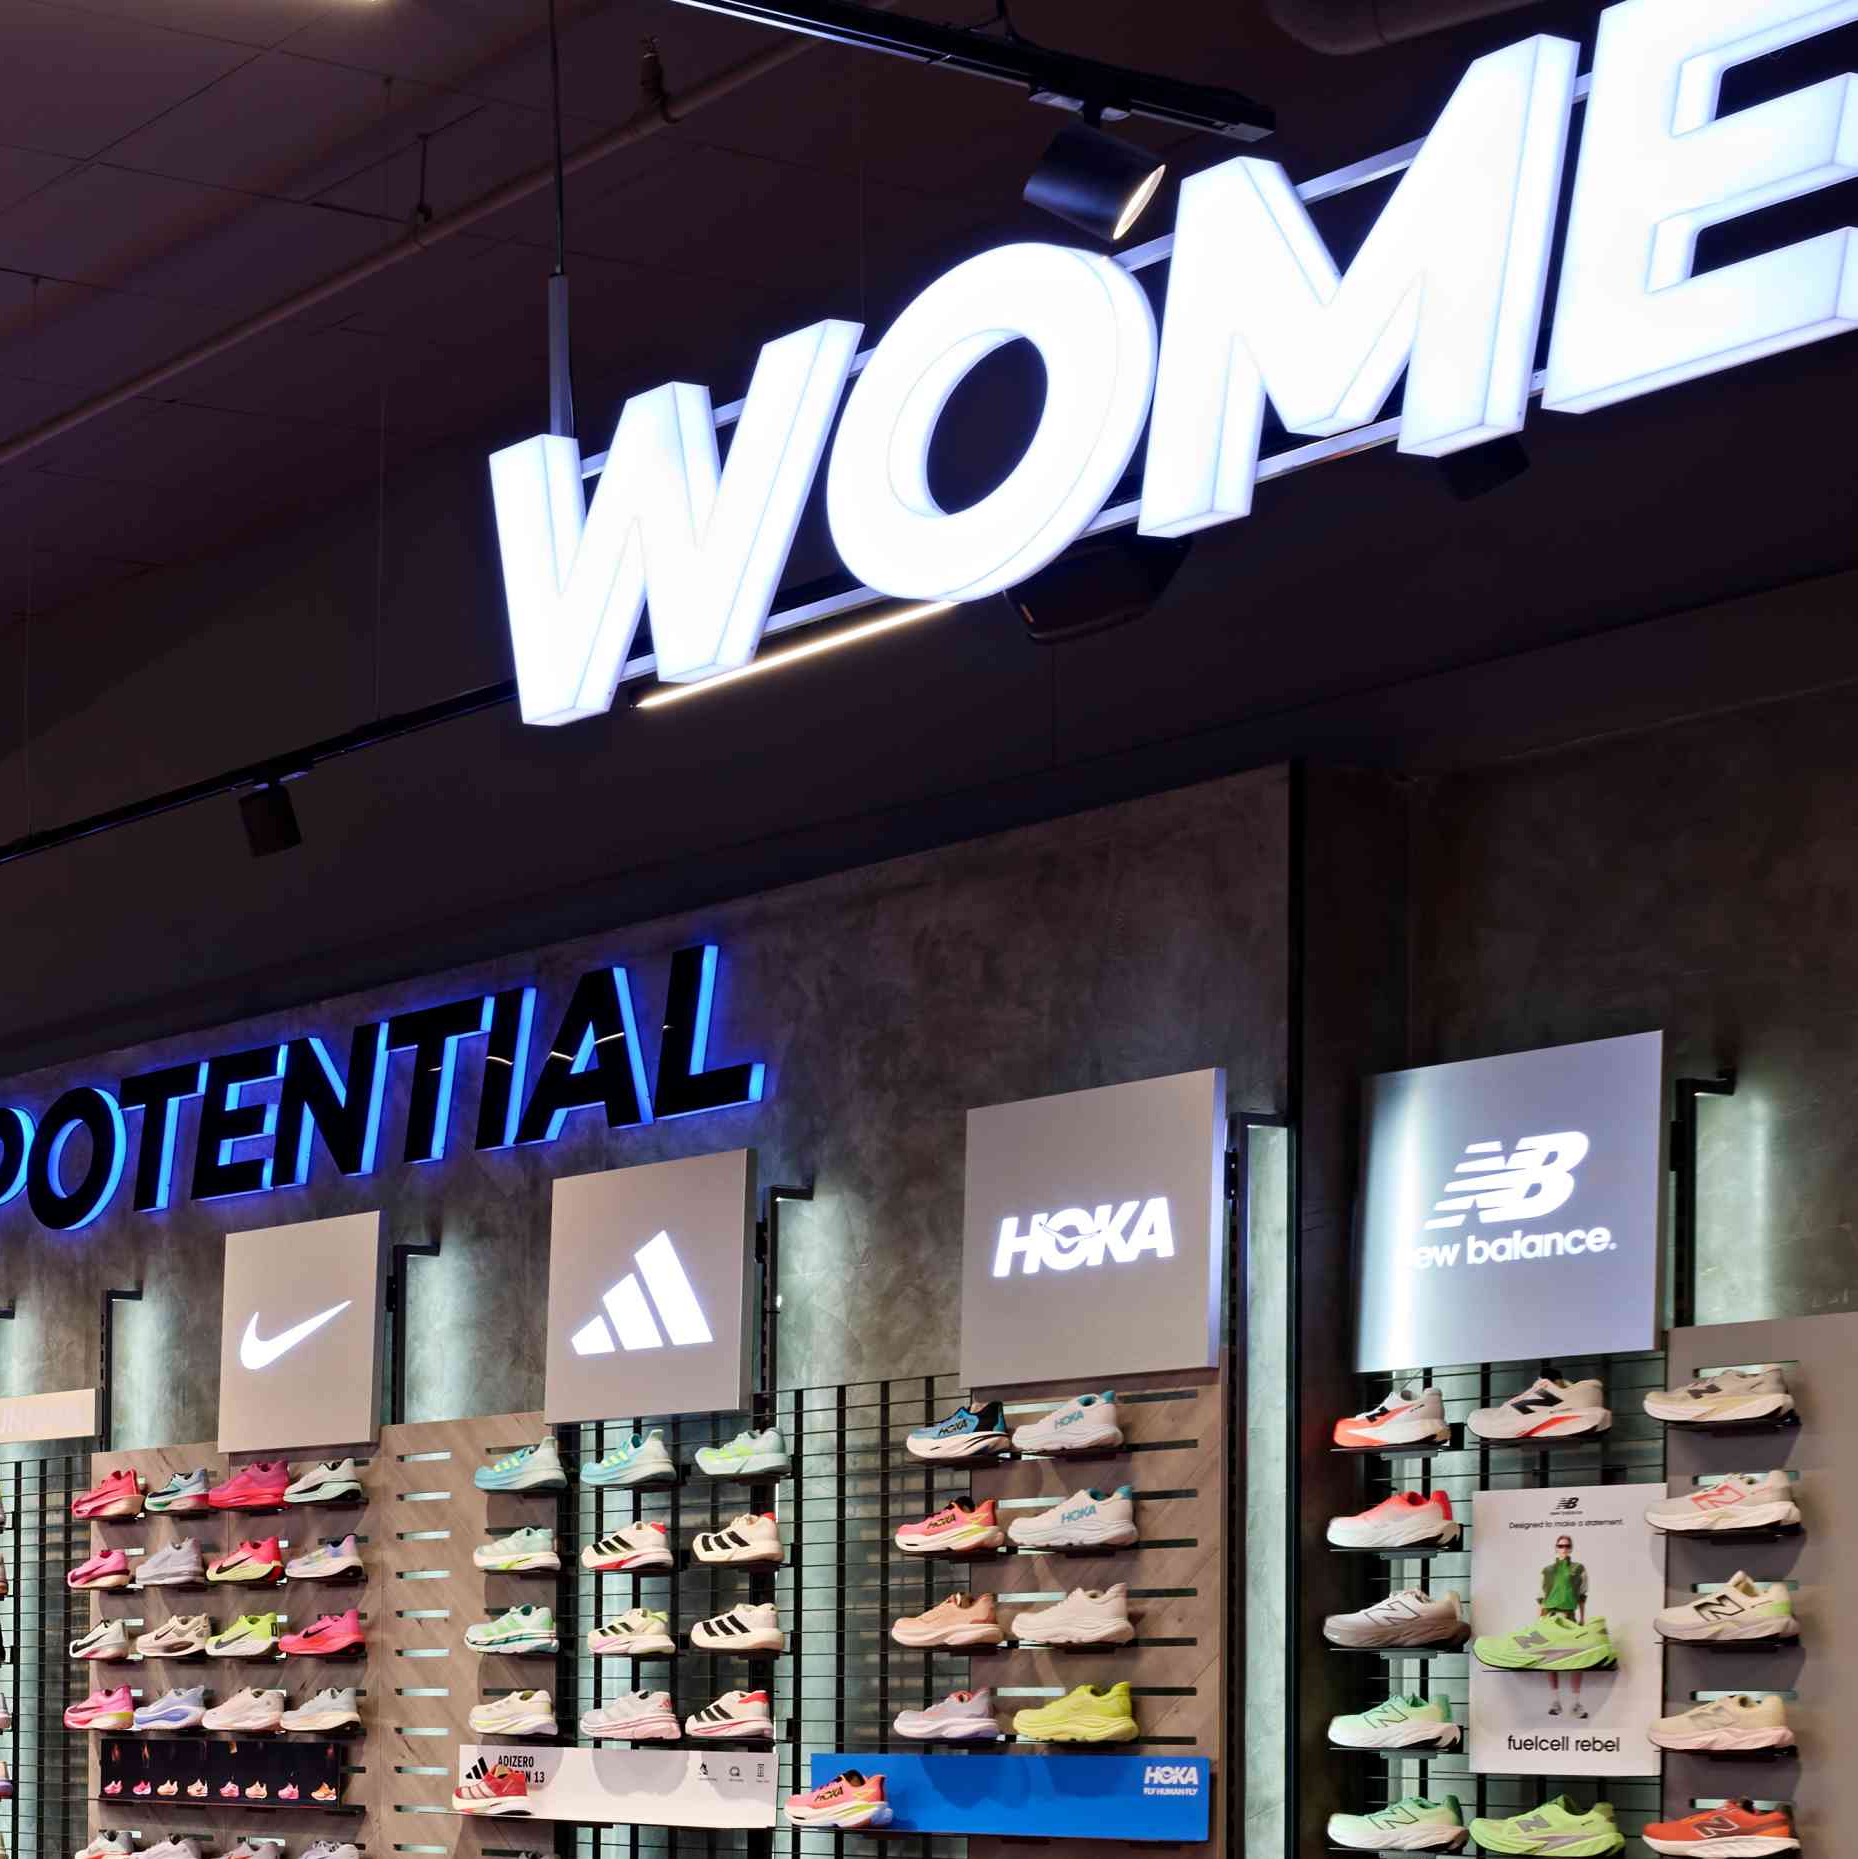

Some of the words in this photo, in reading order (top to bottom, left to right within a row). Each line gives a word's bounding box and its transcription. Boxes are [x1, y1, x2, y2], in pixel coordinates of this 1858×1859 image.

[993, 1196, 1175, 1278] HOKA
[1398, 1243, 1461, 1270] ew
[1061, 1504, 1097, 1524] HOKA
[1508, 1735, 1569, 1751] fuelcell
[1575, 1736, 1620, 1752] rebel
[498, 1755, 534, 1767] ADIZERO
[534, 1771, 545, 1783] 13
[1145, 1766, 1198, 1784] HOKA
